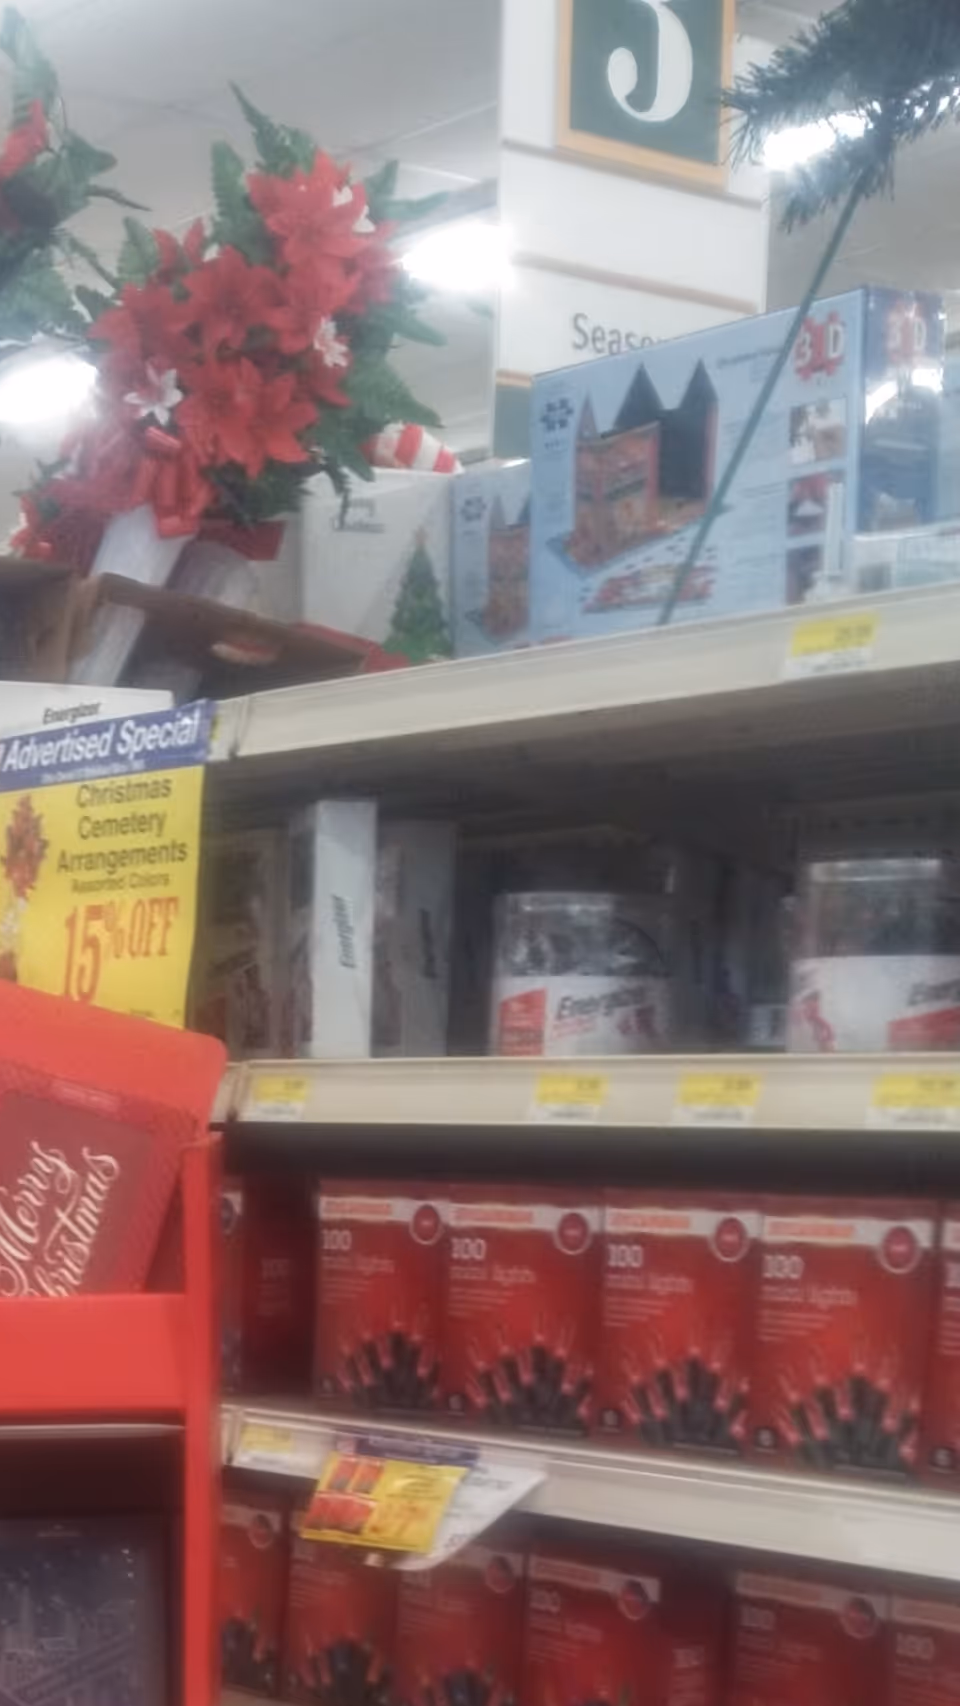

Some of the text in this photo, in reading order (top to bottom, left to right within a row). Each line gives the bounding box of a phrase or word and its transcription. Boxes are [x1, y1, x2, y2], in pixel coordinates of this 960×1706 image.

[572, 312, 660, 356] Seas
[2, 722, 114, 772] Advertised
[117, 707, 202, 760] Special
[76, 778, 172, 808] Christmas
[78, 812, 167, 840] Cemetery
[56, 838, 188, 875] Arrangements
[26, 1146, 120, 1298] hristmas
[451, 1237, 486, 1261] 100
